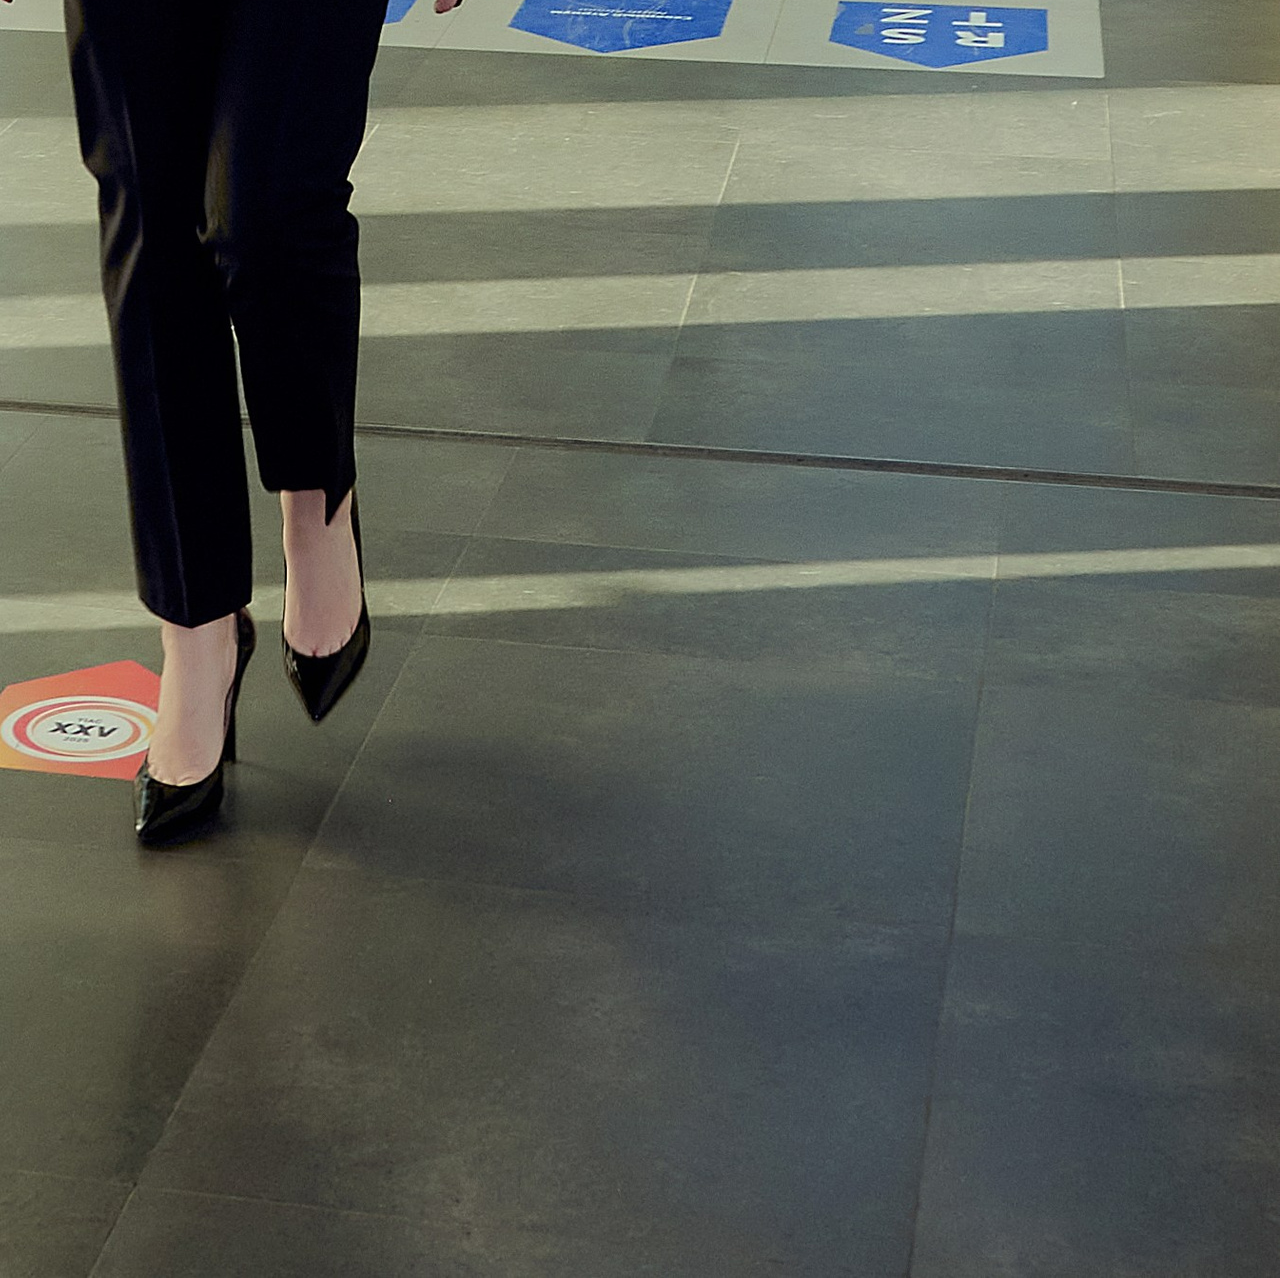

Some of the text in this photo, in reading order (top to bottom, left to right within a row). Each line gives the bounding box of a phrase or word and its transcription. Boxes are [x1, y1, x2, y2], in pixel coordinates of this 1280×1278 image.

[881, 8, 1003, 27] T Z
[881, 28, 1005, 47] R S
[48, 722, 118, 737] XXV
